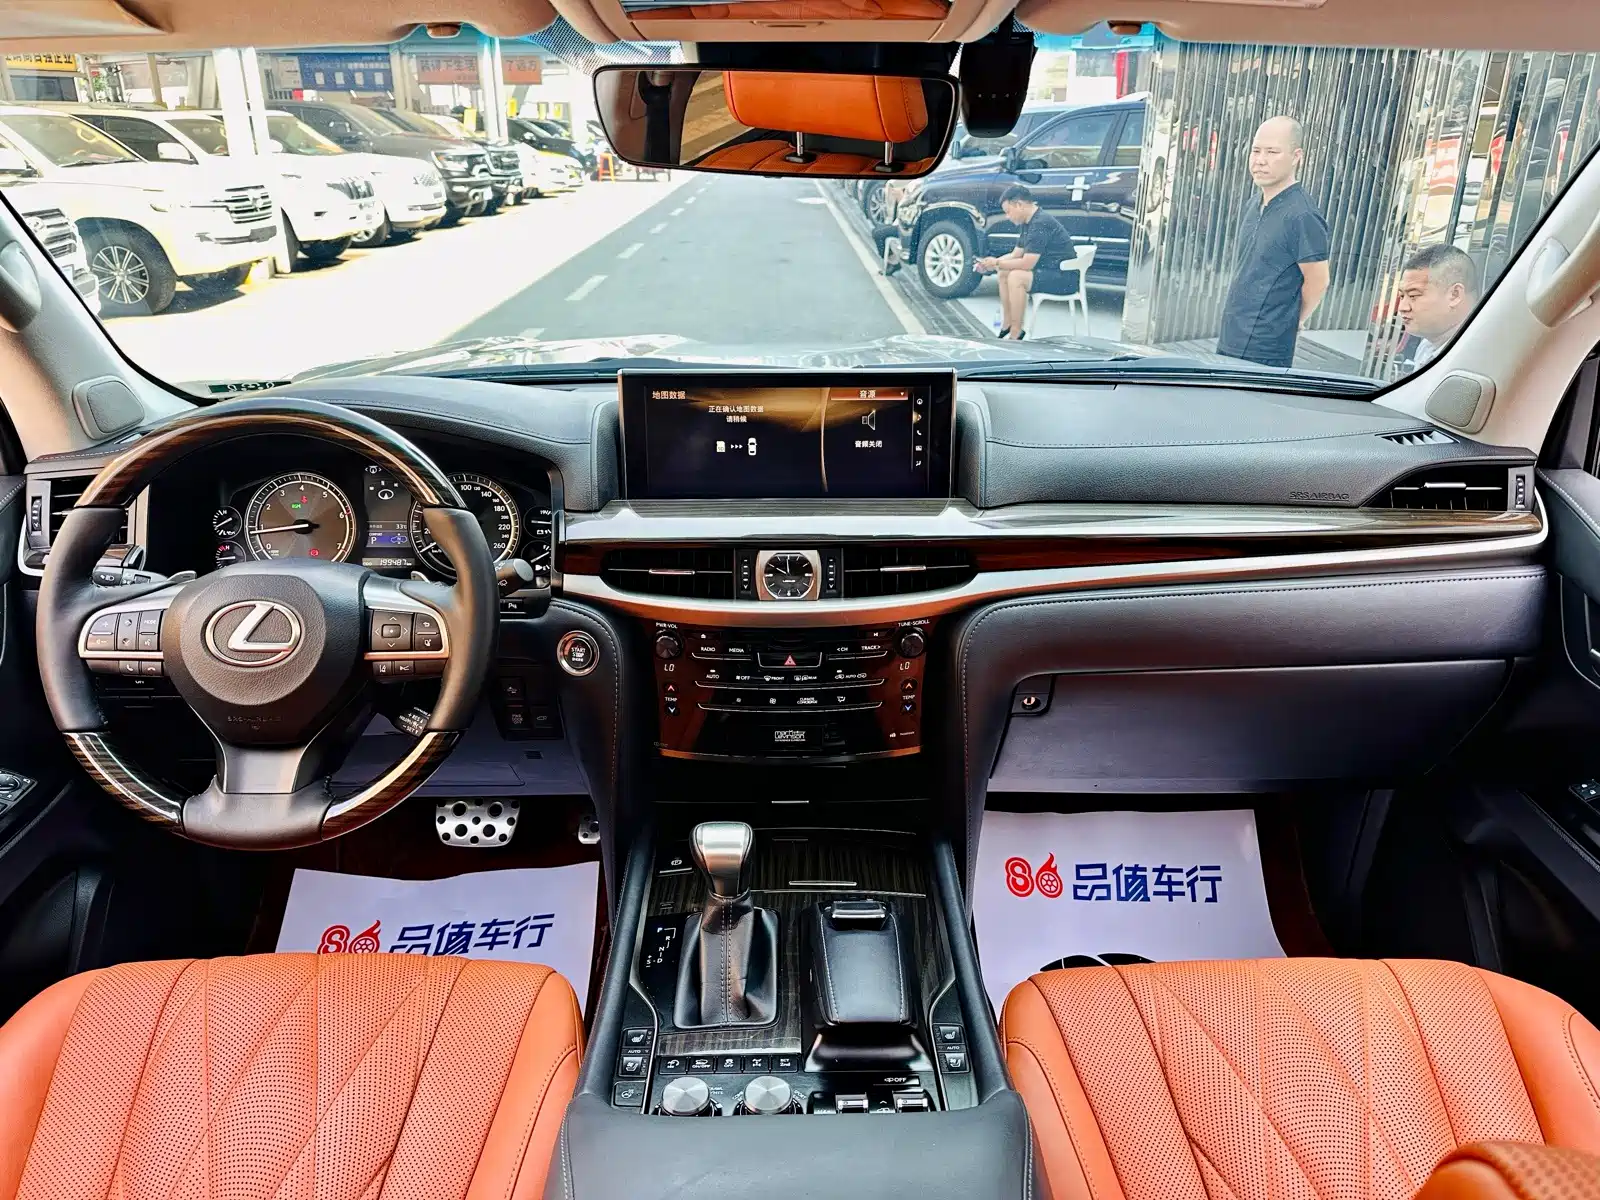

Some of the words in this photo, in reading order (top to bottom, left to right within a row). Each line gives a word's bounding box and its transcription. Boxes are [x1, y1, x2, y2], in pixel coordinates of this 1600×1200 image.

[652, 391, 686, 399] 地图数据
[860, 390, 876, 398] 音源
[708, 405, 764, 413] 正在确认地图数据
[855, 440, 882, 448] 音频关闭
[380, 558, 406, 566] 199487
[1073, 862, 1222, 903] 品值车行
